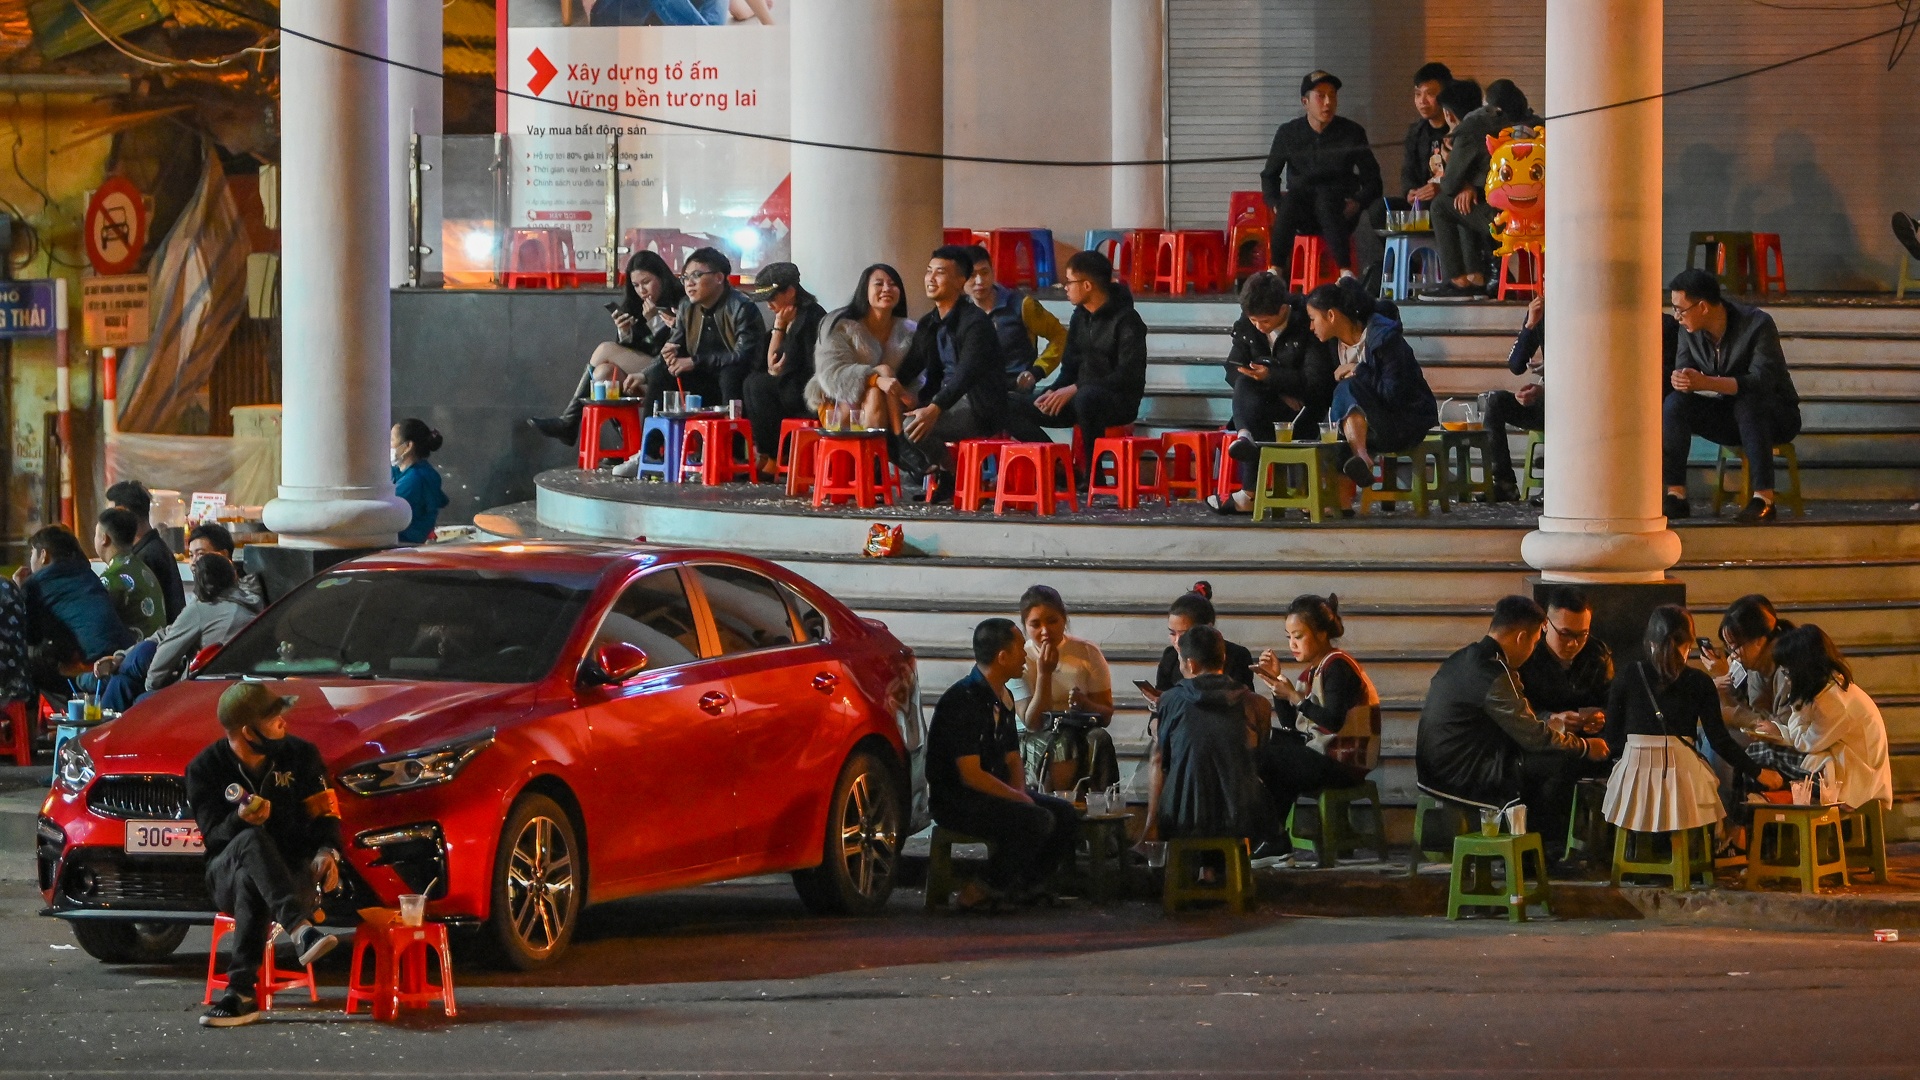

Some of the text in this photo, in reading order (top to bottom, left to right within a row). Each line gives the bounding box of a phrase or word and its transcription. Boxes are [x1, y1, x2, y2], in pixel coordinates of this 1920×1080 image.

[567, 60, 719, 85] Xây dựng tổ ấm
[567, 87, 757, 111] Vững bền tương lai
[526, 123, 647, 137] Vay mua bất động sản
[583, 152, 595, 161] giá
[10, 303, 46, 328] THÁI
